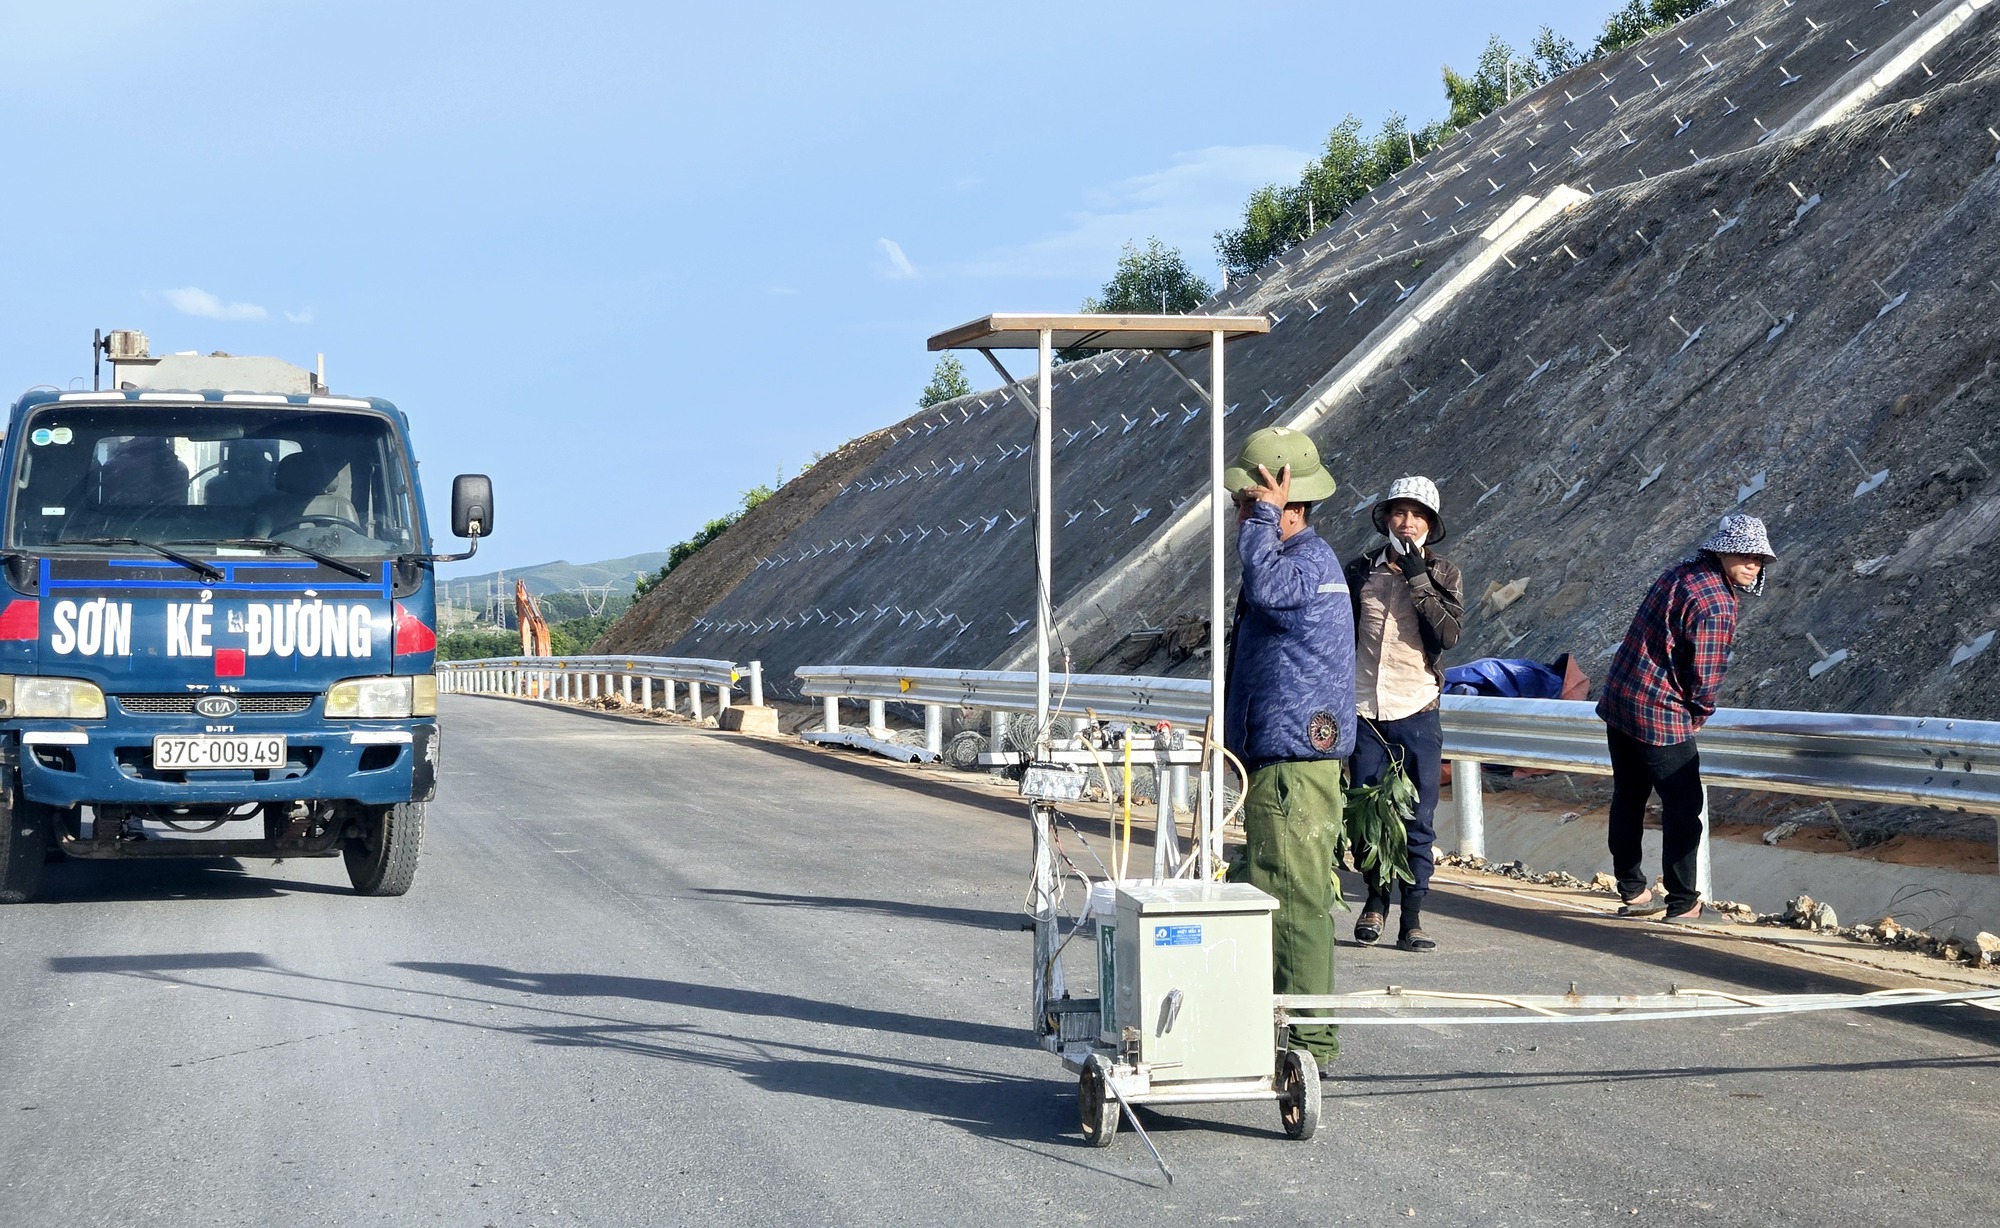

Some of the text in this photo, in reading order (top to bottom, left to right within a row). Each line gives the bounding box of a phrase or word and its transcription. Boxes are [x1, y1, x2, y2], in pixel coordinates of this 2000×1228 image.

[51, 590, 371, 657] SƠN KẺ ĐƯỜNG
[203, 702, 231, 713] KIA
[160, 741, 280, 763] 37C-009.49
